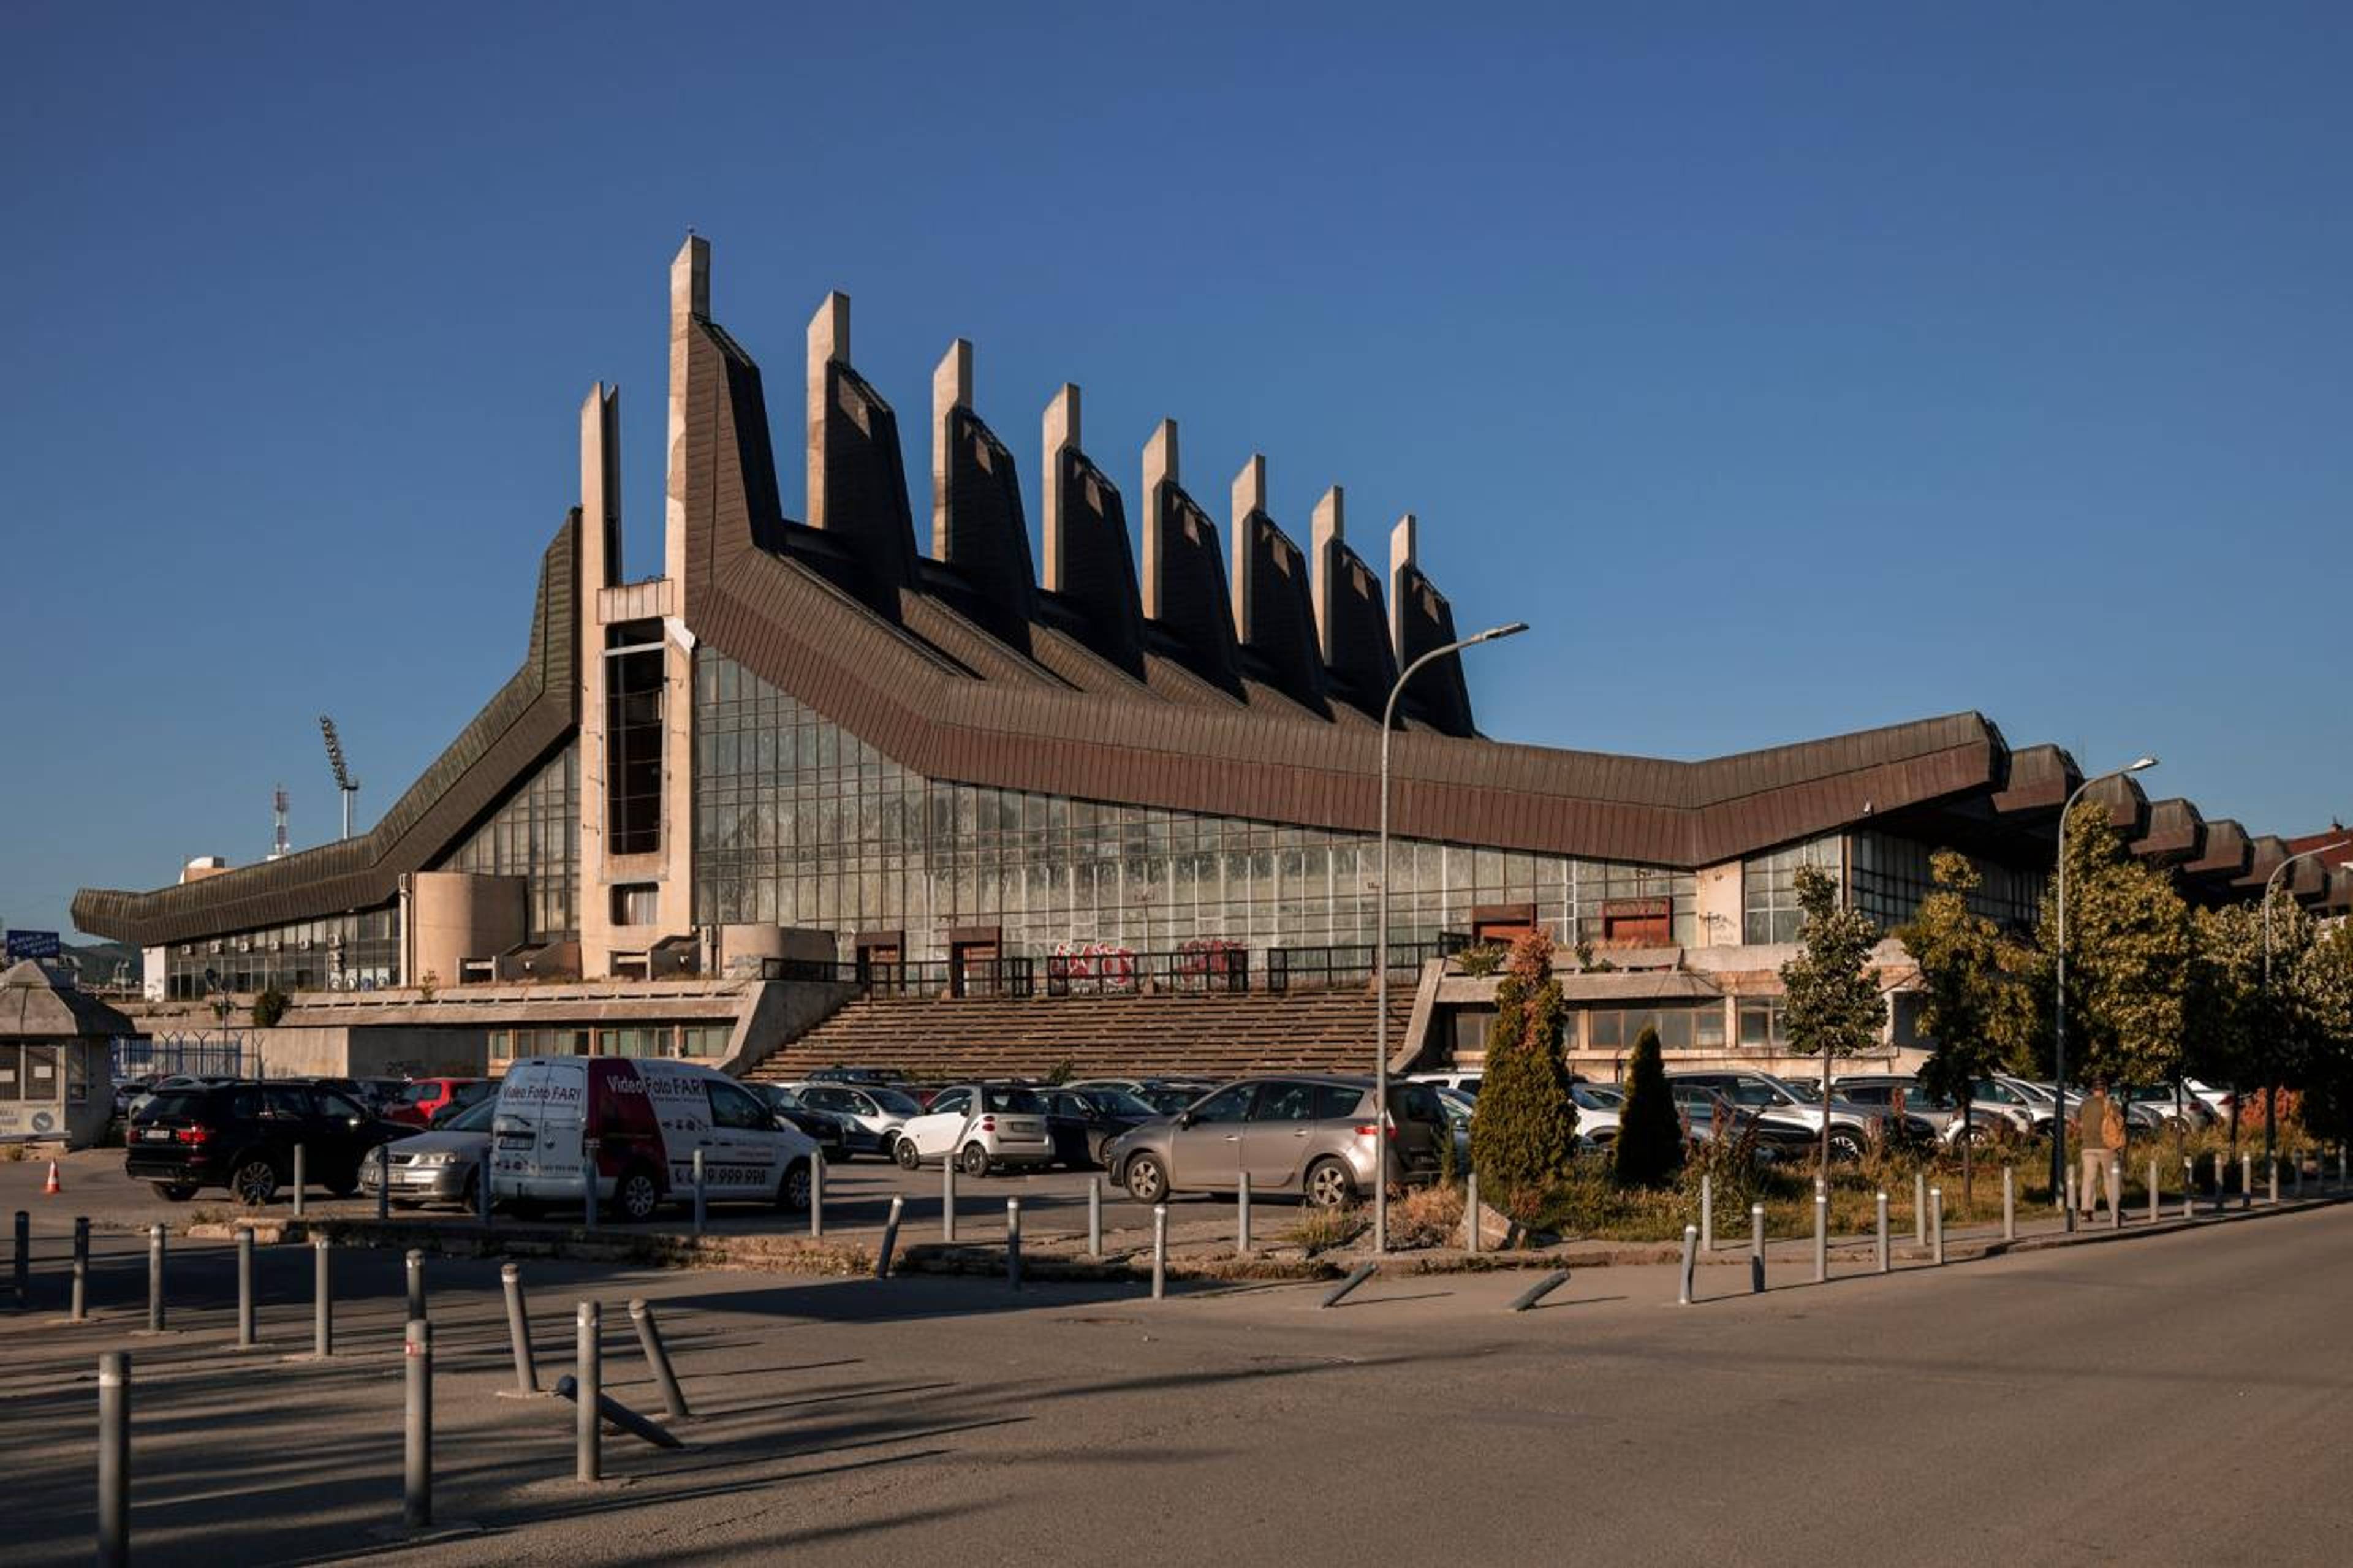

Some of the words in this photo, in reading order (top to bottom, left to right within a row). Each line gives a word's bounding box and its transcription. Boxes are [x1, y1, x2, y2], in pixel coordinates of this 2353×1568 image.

[504, 1086, 526, 1099] Video
[528, 1085, 550, 1099] Foto
[607, 1075, 643, 1093] Video
[645, 1077, 672, 1094] Foto
